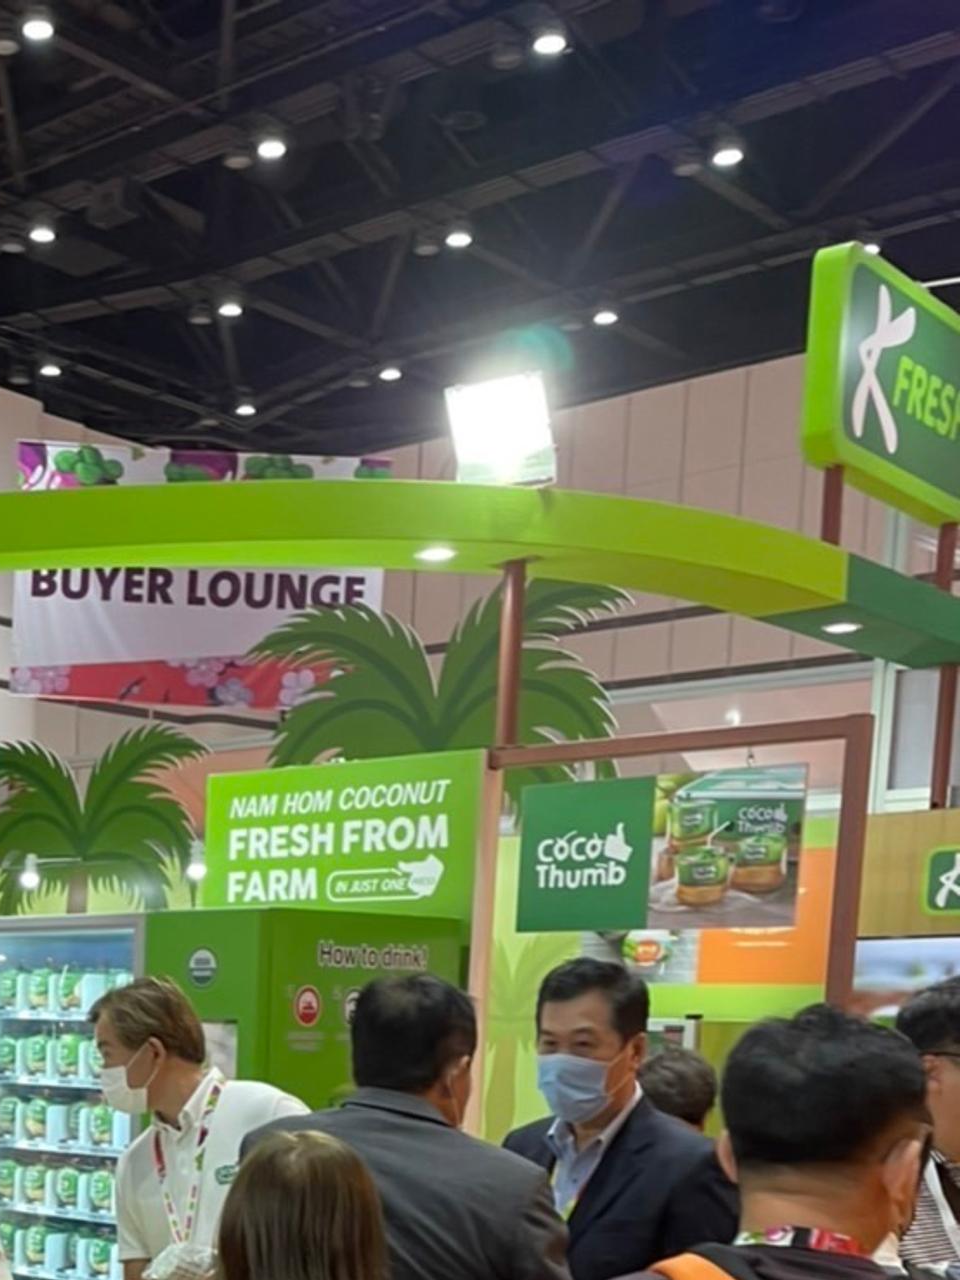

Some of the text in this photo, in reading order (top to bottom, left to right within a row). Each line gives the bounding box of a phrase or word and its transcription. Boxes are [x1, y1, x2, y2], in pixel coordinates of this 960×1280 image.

[30, 566, 366, 610] BUYER LOUNGE
[229, 779, 452, 820] NAM HOM COCONUT
[228, 814, 449, 861] FRESH FROM
[227, 867, 317, 903] FARM
[350, 878, 378, 892] JUST
[381, 876, 407, 891] ONE
[535, 861, 627, 889] Thumb
[319, 940, 357, 967] How
[361, 946, 378, 968] to
